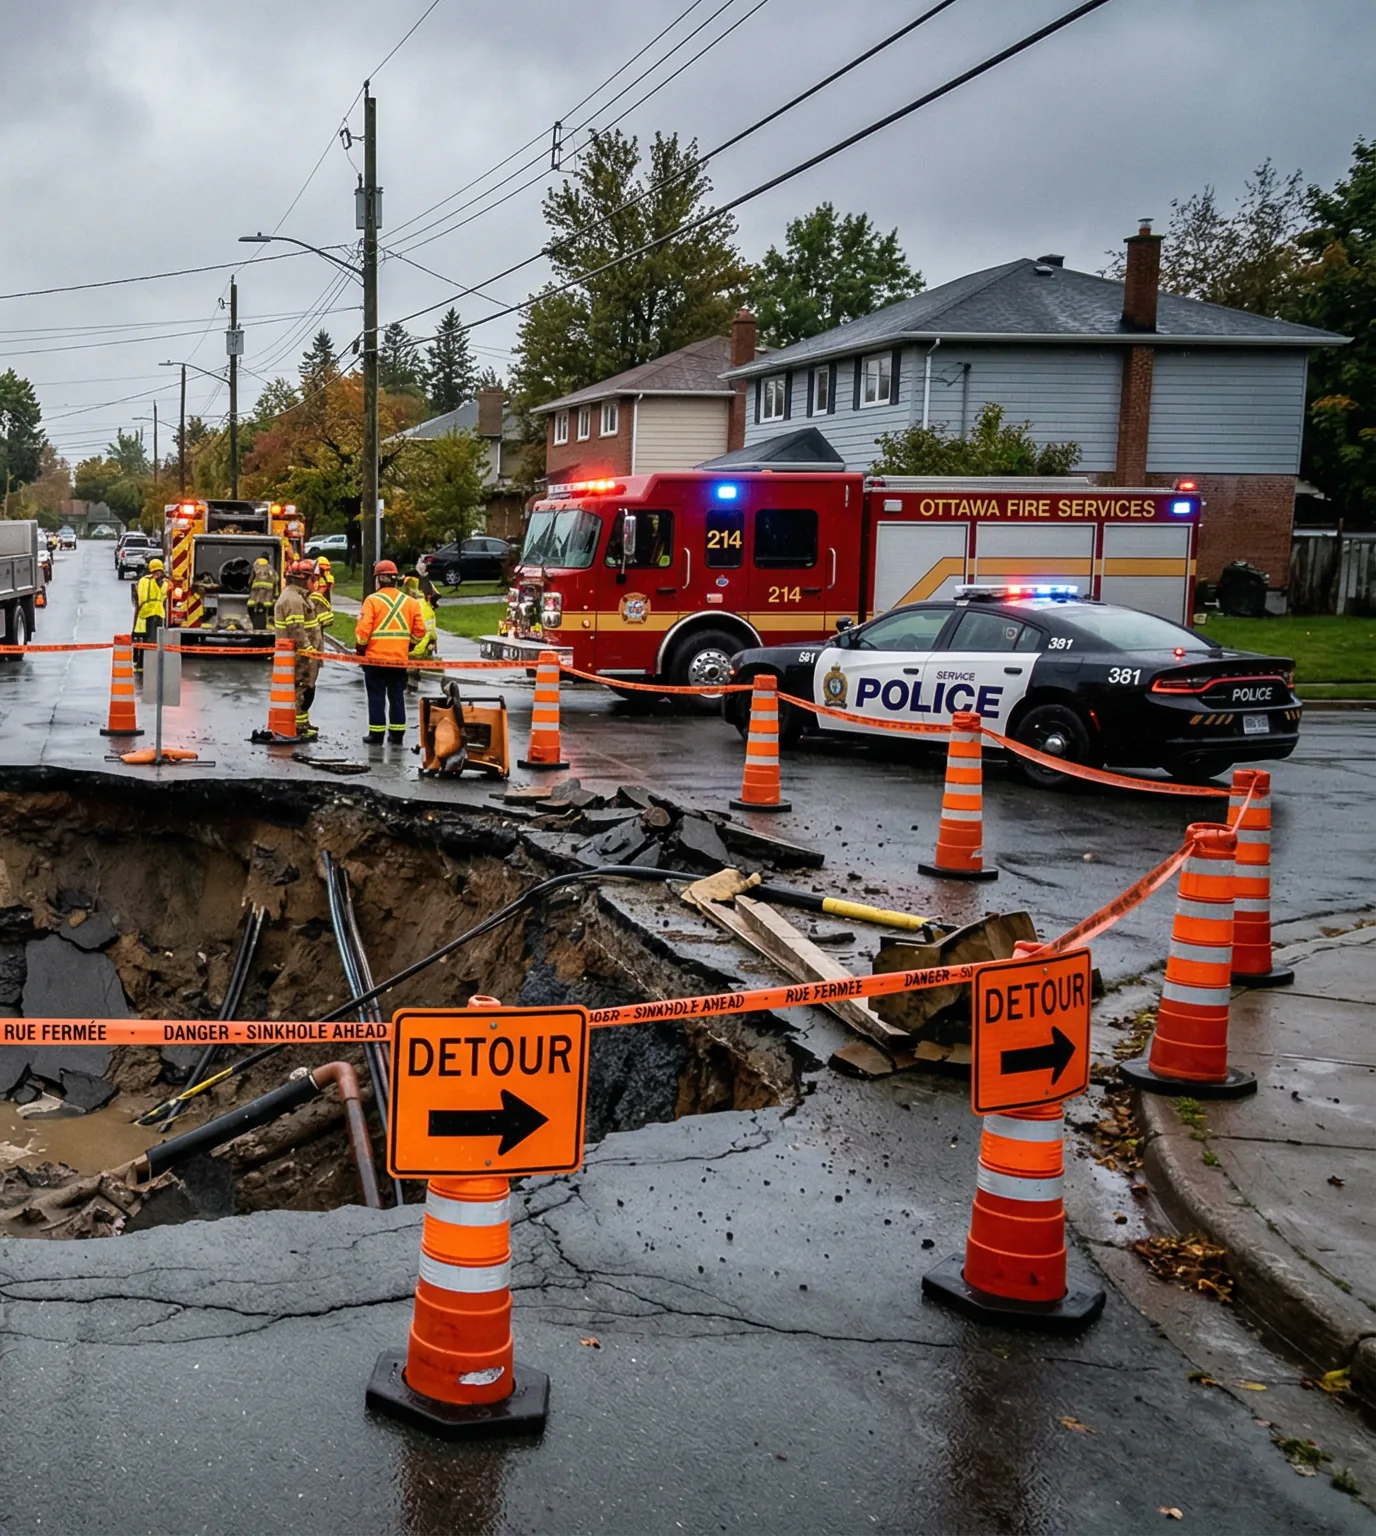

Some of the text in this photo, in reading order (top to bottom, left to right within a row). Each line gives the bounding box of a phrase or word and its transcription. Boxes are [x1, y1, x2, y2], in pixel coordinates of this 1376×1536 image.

[919, 498, 1156, 518] OTTAWA FIRE SERVICES
[707, 530, 742, 549] 214
[768, 586, 802, 603] 214
[1048, 637, 1073, 650] 381
[1108, 667, 1141, 685] 381
[855, 677, 1004, 719] POLICE
[1232, 687, 1273, 701] POLICE
[985, 973, 1085, 1024] DETOUR
[4, 1020, 107, 1041] RUE FERMÉE
[164, 1025, 229, 1041] DANGER
[246, 1024, 328, 1040] SINKHOLE
[332, 1023, 387, 1039] AHEAD
[408, 1035, 572, 1077] DETOUR
